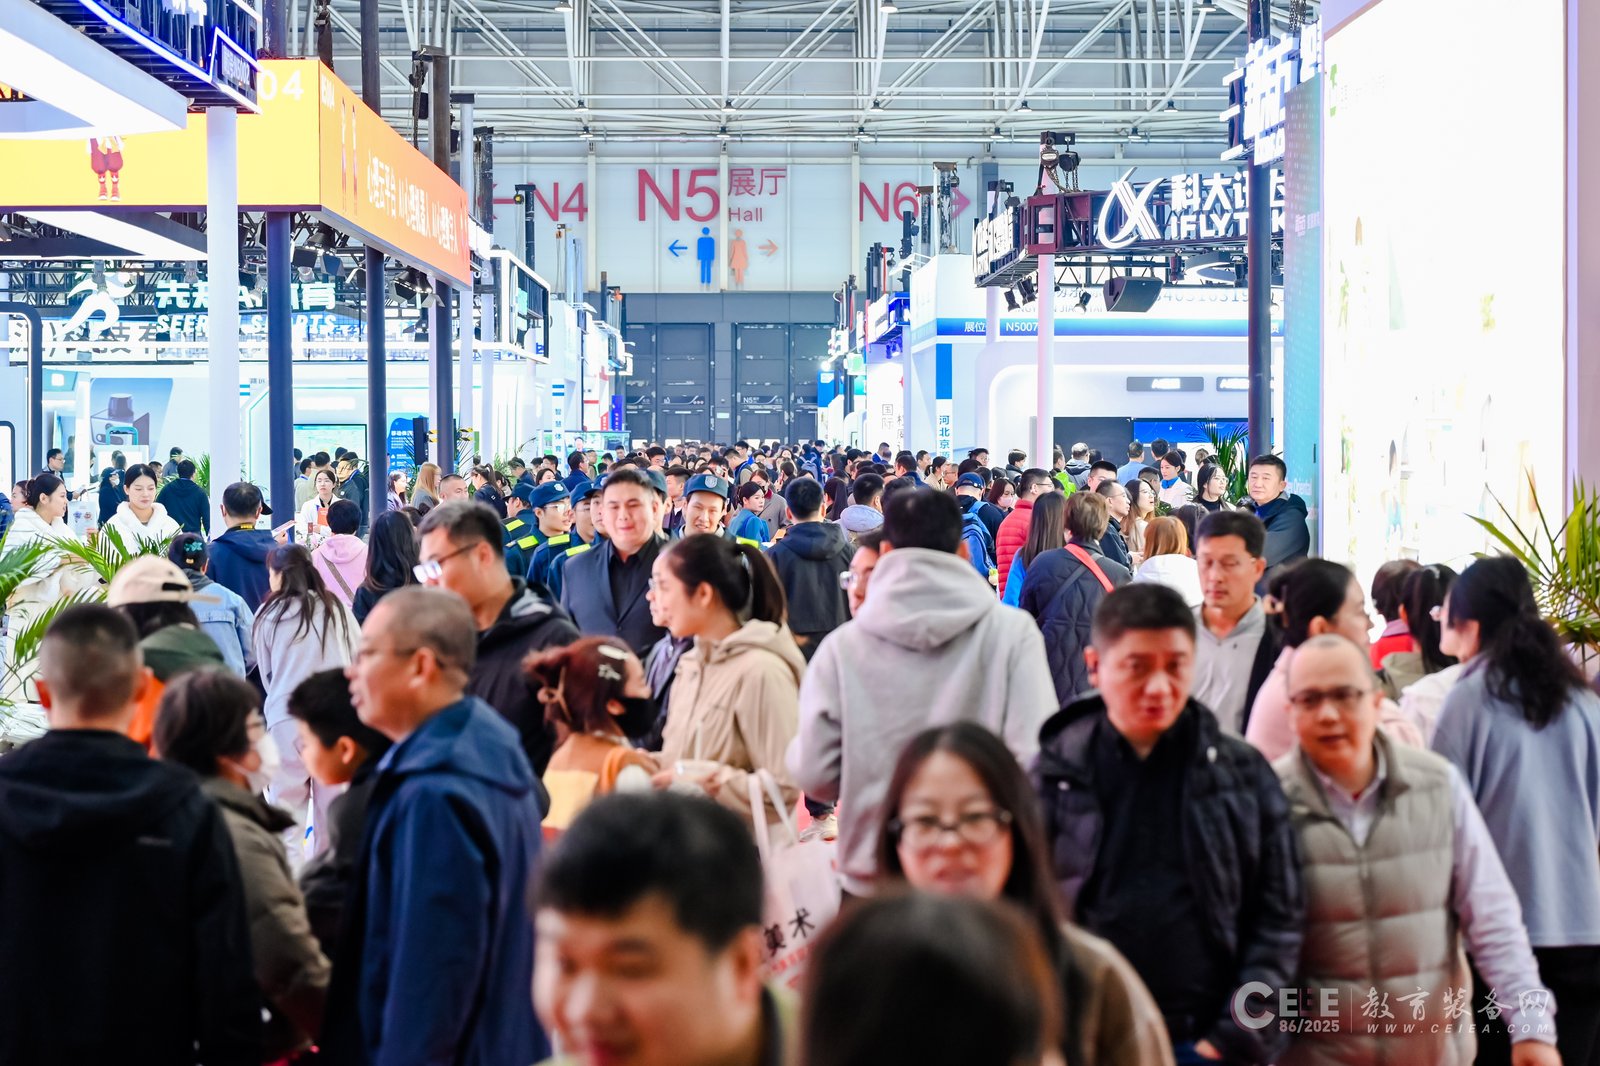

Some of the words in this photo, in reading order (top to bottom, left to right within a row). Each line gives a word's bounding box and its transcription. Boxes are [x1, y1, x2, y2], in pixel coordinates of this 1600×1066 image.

[638, 168, 720, 222] N5
[728, 168, 787, 197] 展厅
[527, 182, 588, 221] N4
[728, 207, 762, 222] Hall
[860, 182, 919, 222] N6
[1006, 322, 1038, 332] N5007
